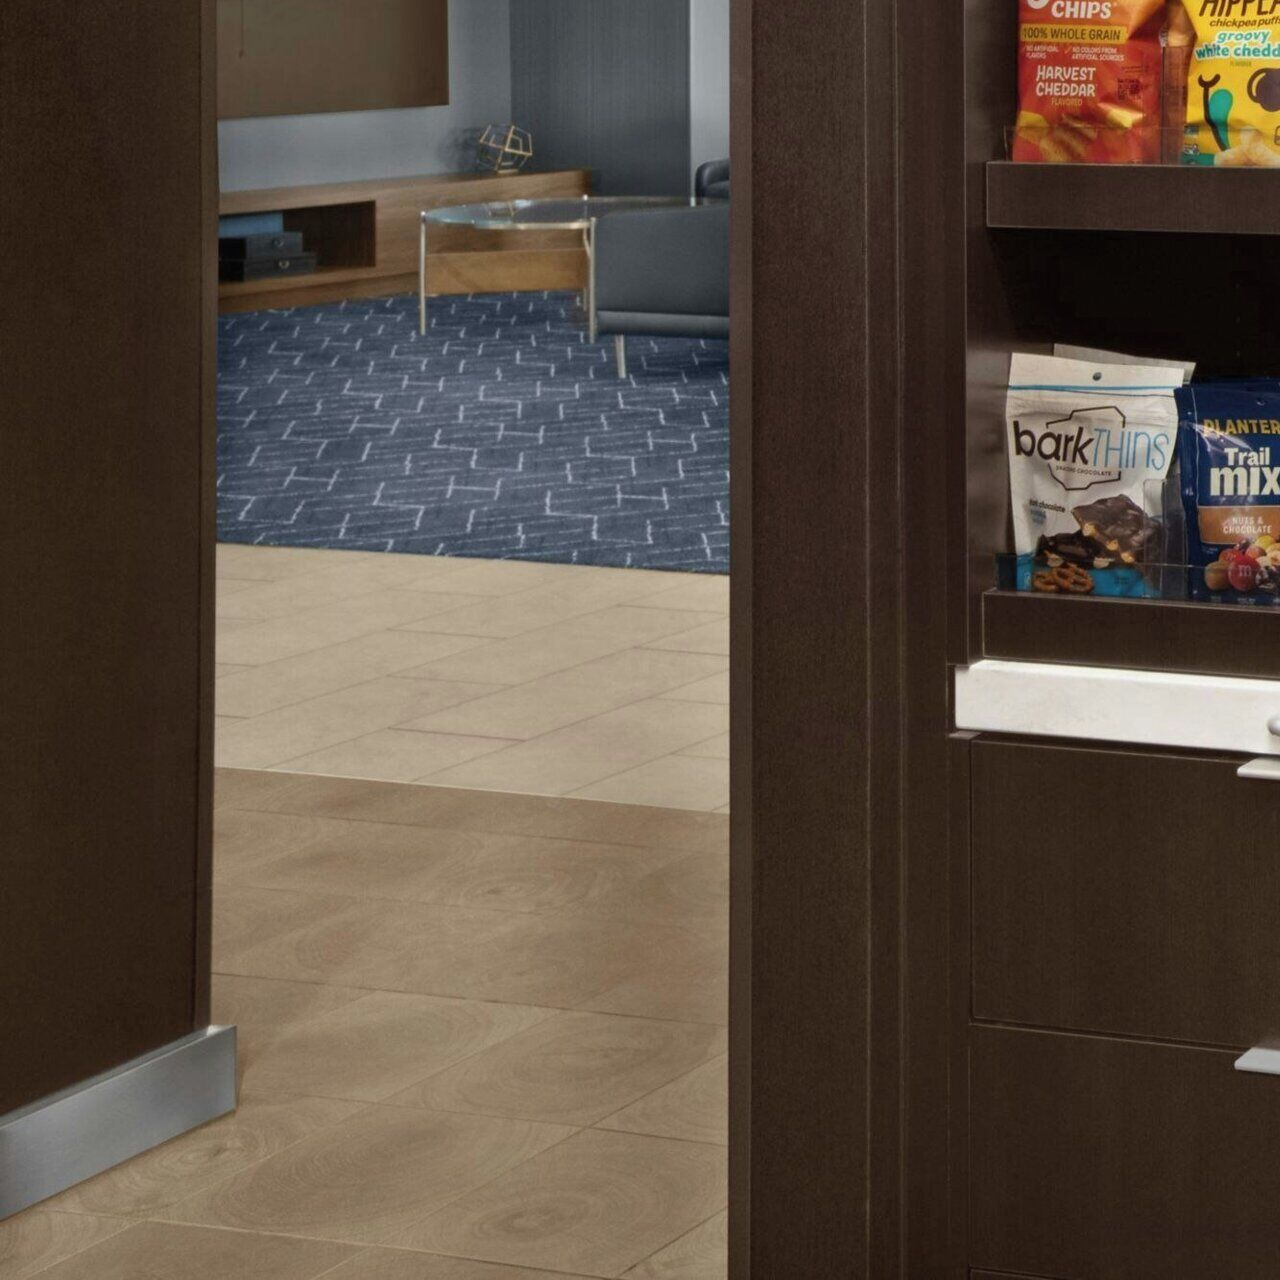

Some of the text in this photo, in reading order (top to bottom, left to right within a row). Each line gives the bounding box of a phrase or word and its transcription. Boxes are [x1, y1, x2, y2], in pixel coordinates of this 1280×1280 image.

[1052, 0, 1112, 19] CHIPS
[1210, 17, 1258, 29] chickpea
[1023, 27, 1121, 41] 100% WHOLE GRAIN
[1217, 30, 1271, 46] groovy
[1196, 44, 1230, 60] white
[1036, 65, 1097, 81] HARVEST
[1036, 82, 1096, 97] CHEDDAR
[1224, 446, 1271, 466] Trail
[1223, 524, 1273, 535] CHOCOLATE
